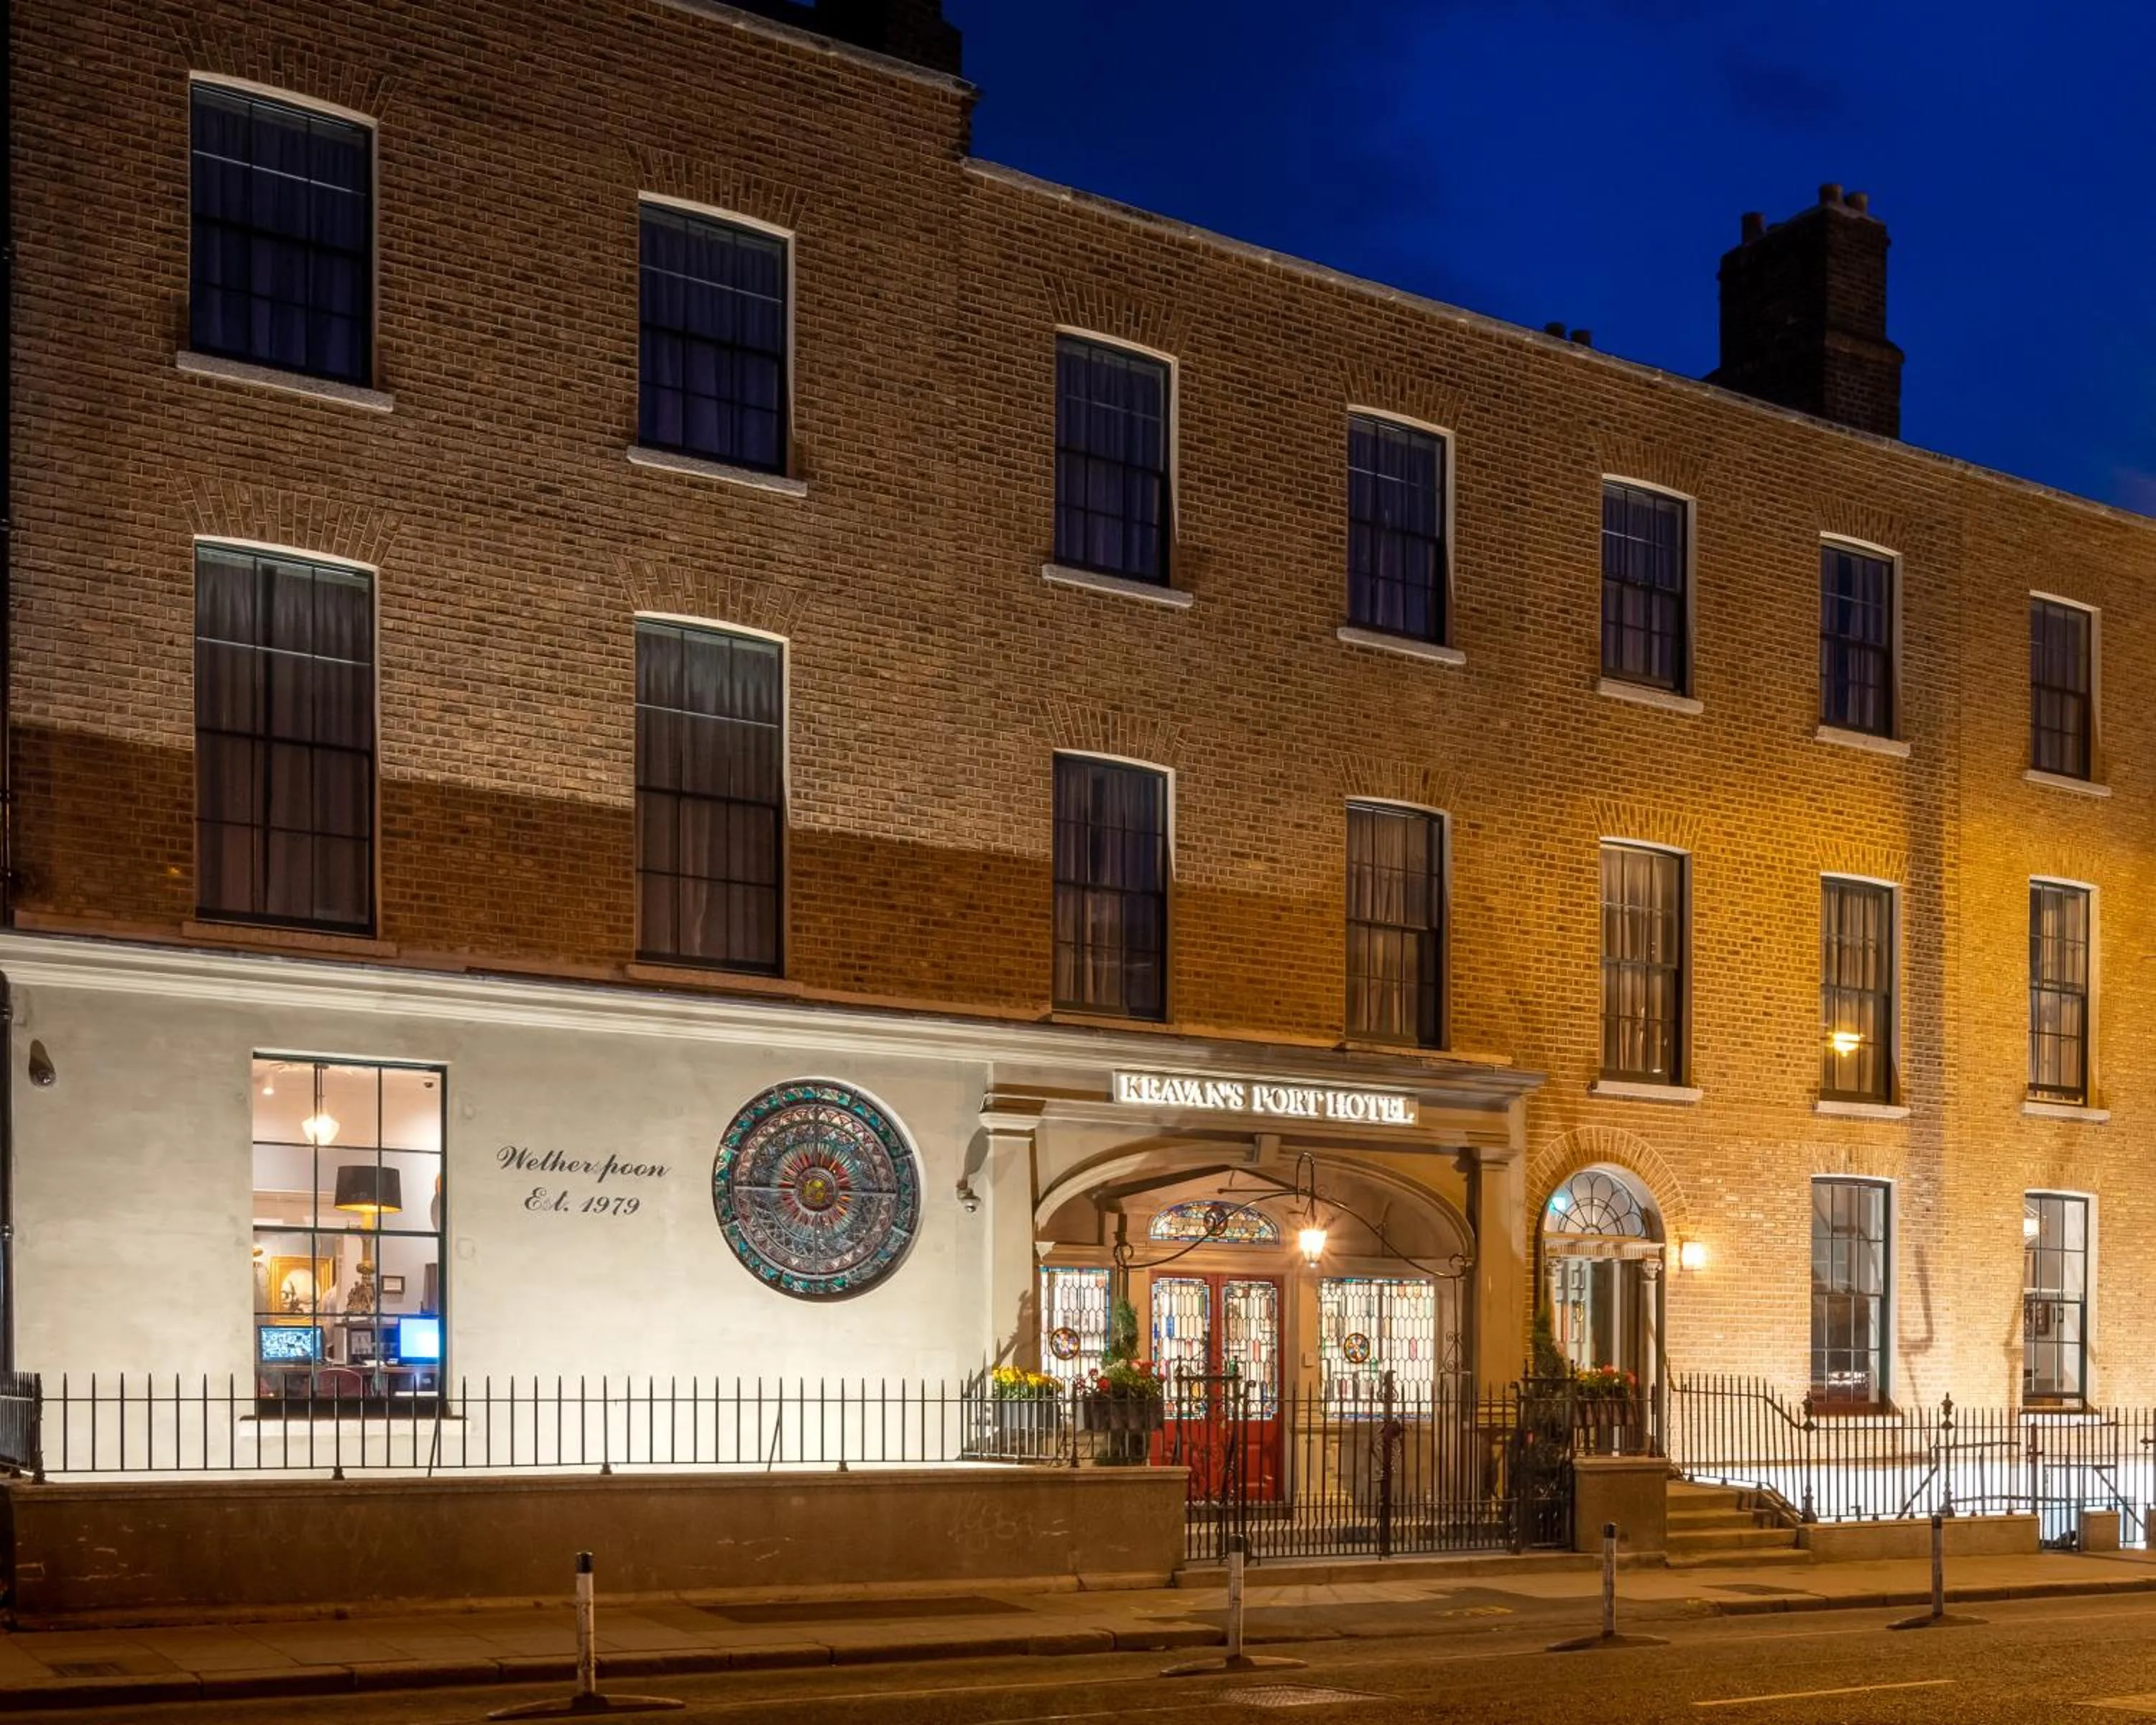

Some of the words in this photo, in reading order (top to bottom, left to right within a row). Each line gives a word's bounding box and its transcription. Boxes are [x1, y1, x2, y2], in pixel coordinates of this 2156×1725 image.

[1252, 1085, 1324, 1116] PORT
[1326, 1091, 1415, 1124] HOTEL
[581, 1196, 640, 1216] 1979
